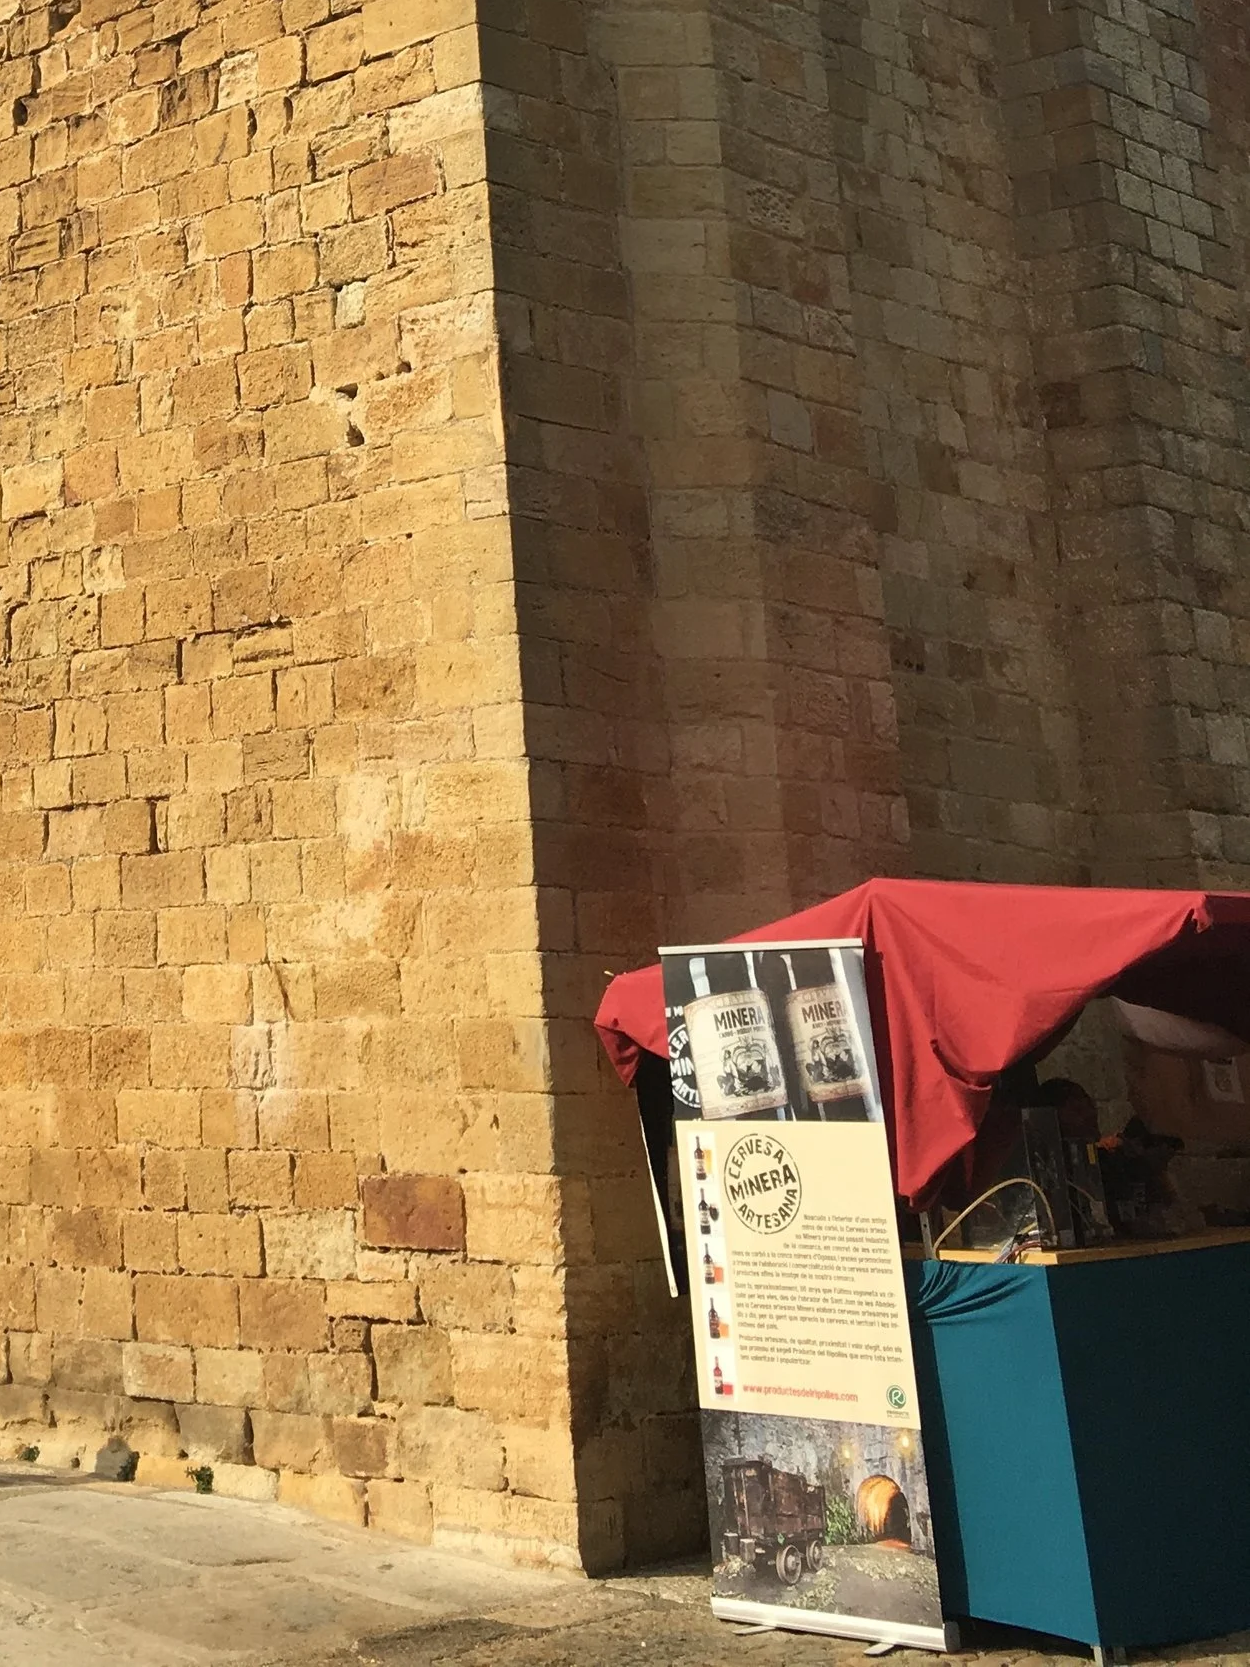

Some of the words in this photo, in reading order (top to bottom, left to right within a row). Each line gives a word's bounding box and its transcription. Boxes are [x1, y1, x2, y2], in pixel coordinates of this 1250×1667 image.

[714, 1006, 765, 1032] MINERA
[728, 1139, 784, 1179] CERVESA
[729, 1164, 796, 1202] MINERA
[738, 1189, 798, 1228] ARTESANA
